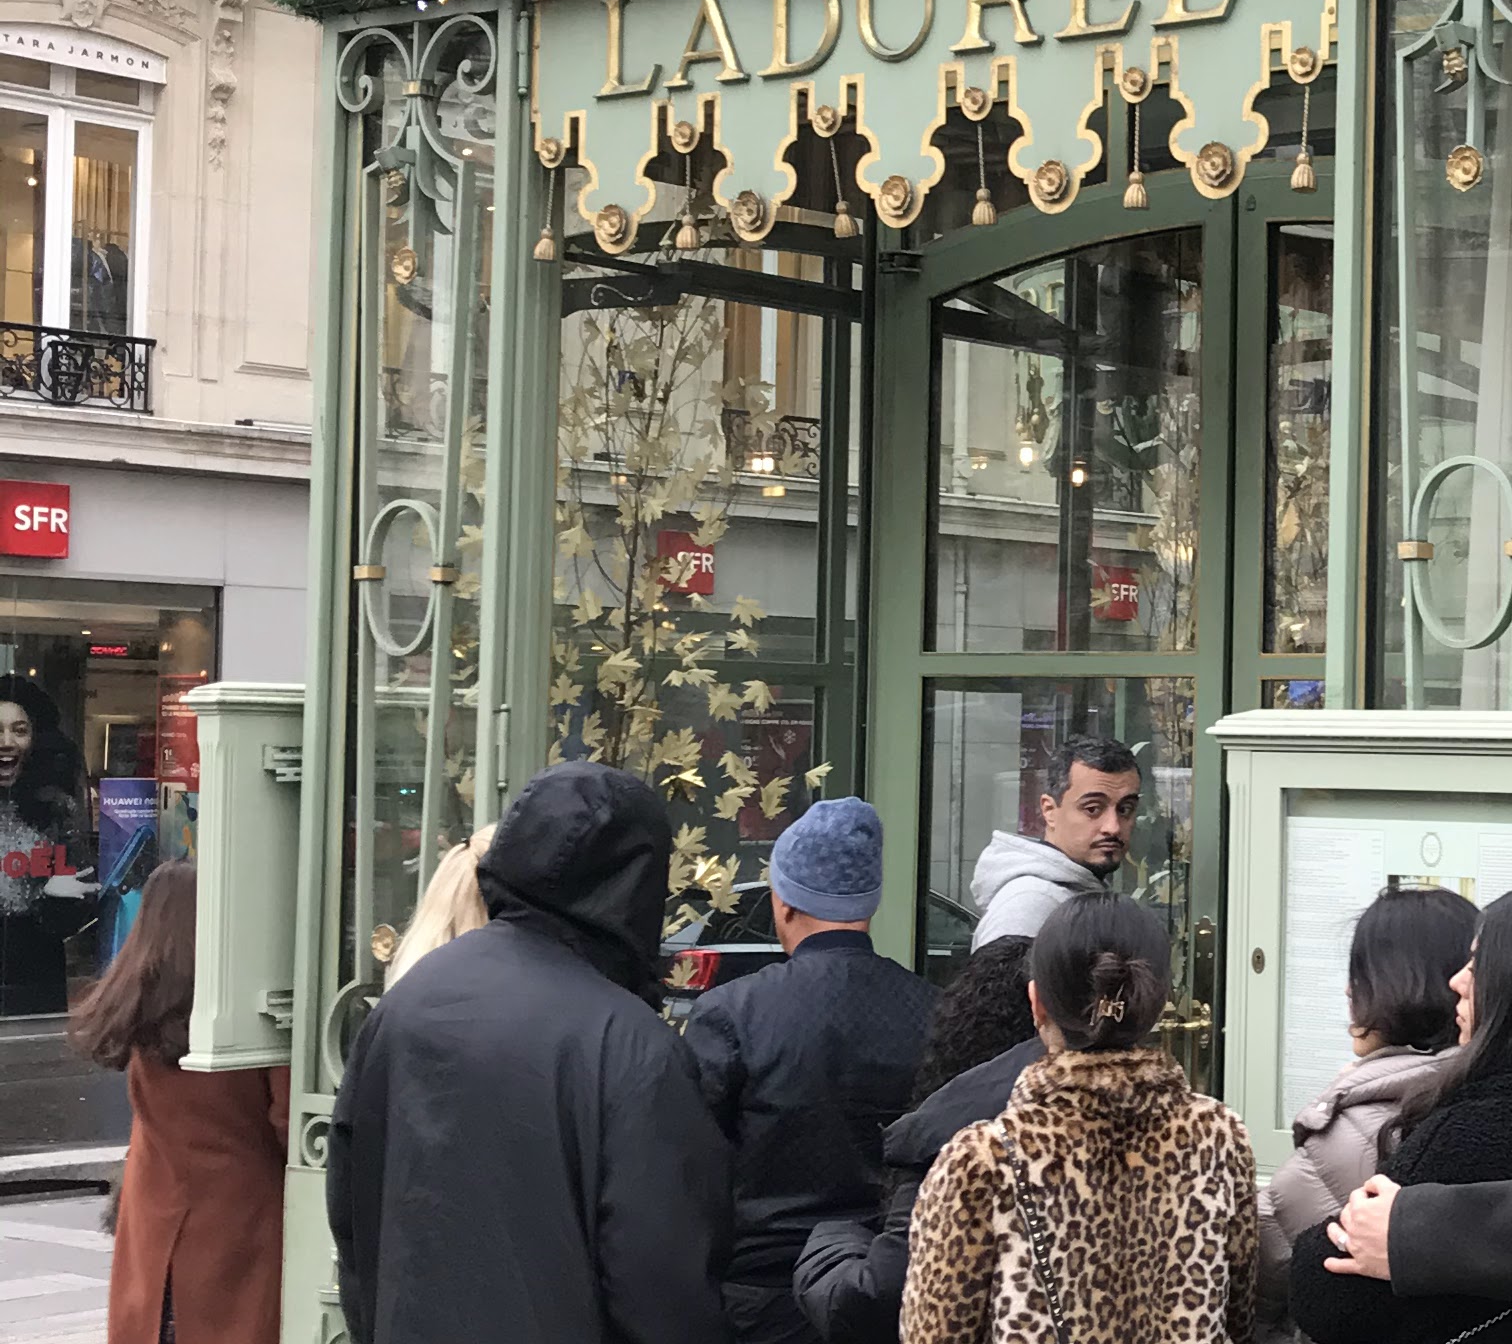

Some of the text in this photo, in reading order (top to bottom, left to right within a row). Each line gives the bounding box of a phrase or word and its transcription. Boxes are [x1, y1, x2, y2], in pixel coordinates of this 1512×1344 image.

[3, 33, 150, 69] TARA JARMON
[14, 504, 68, 534] SFR
[103, 797, 142, 806] HUAWEI
